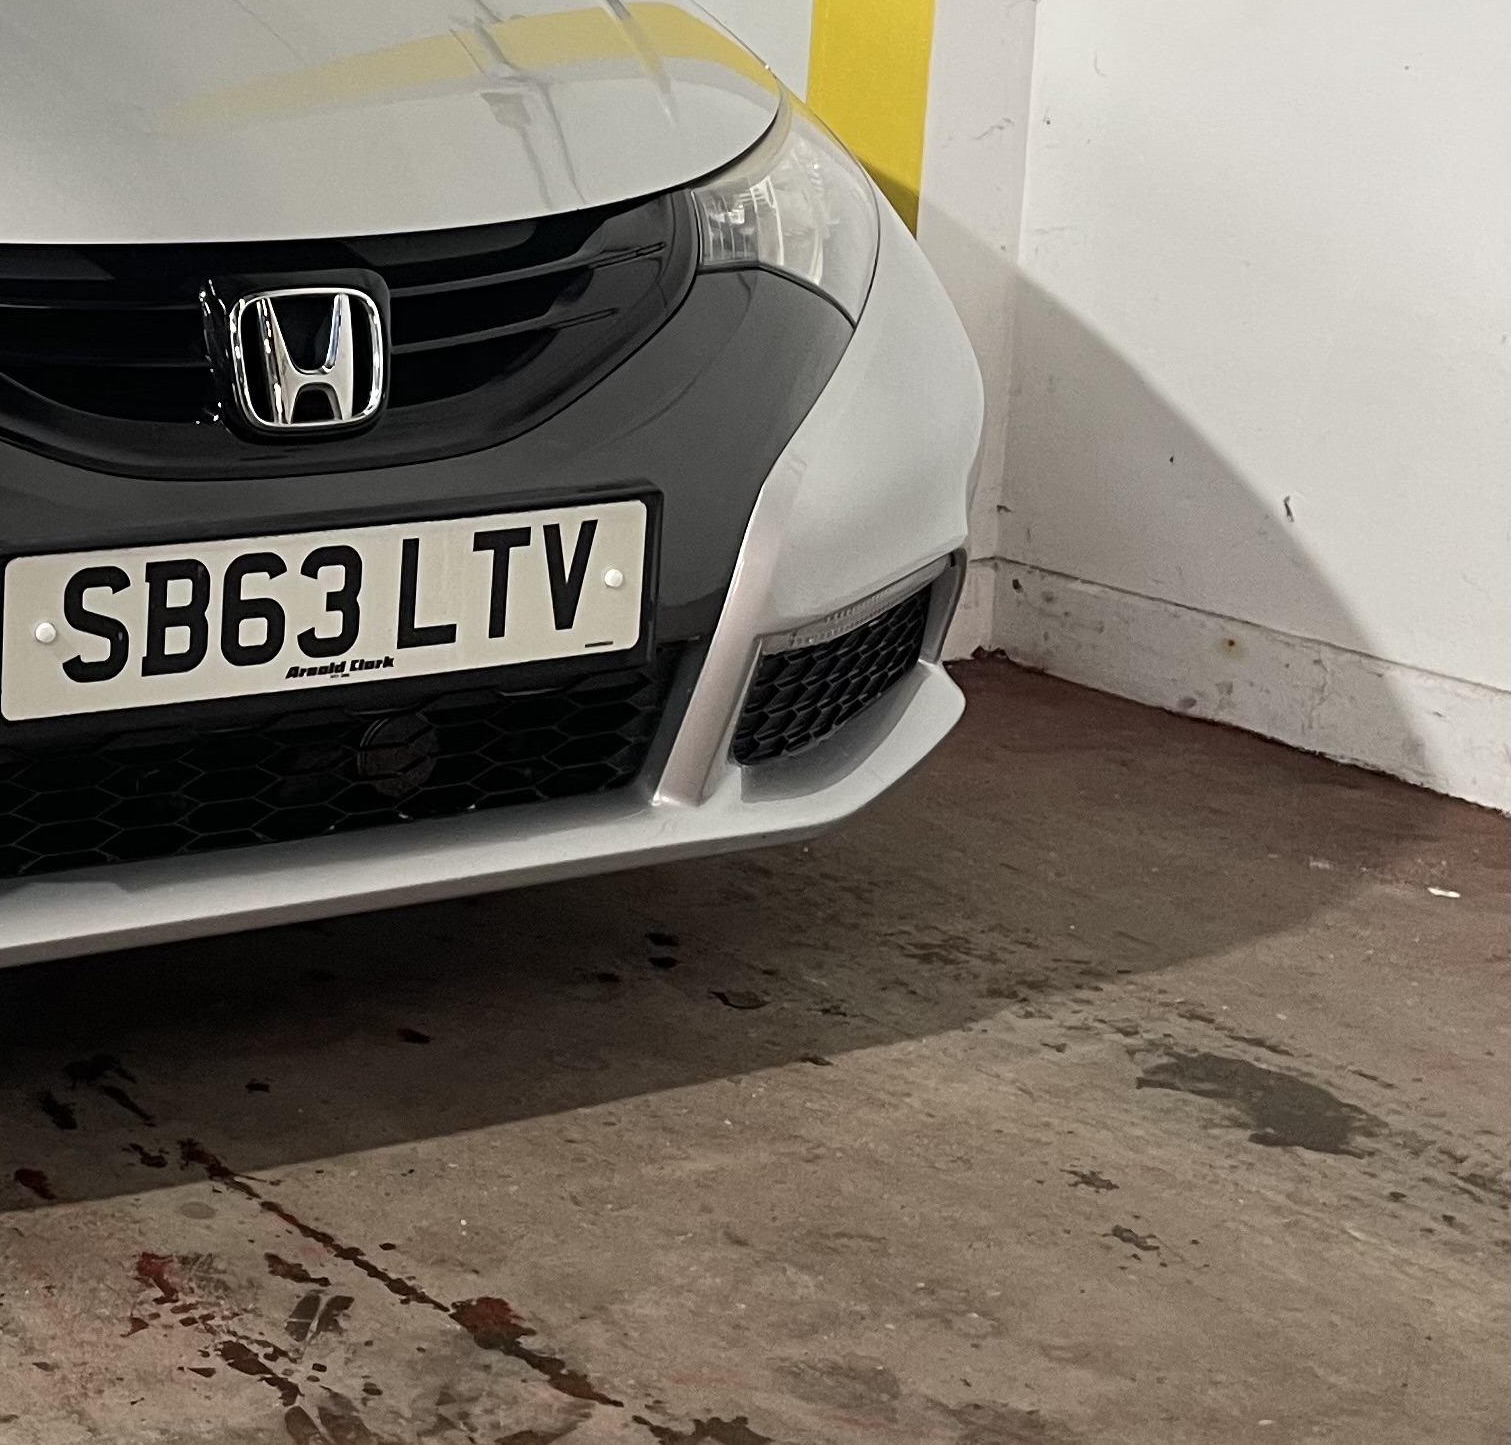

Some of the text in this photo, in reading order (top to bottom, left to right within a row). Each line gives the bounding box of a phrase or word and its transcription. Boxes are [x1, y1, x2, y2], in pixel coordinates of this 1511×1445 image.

[61, 519, 598, 683] SB63 LTV
[285, 656, 394, 679] Arnold Clark
